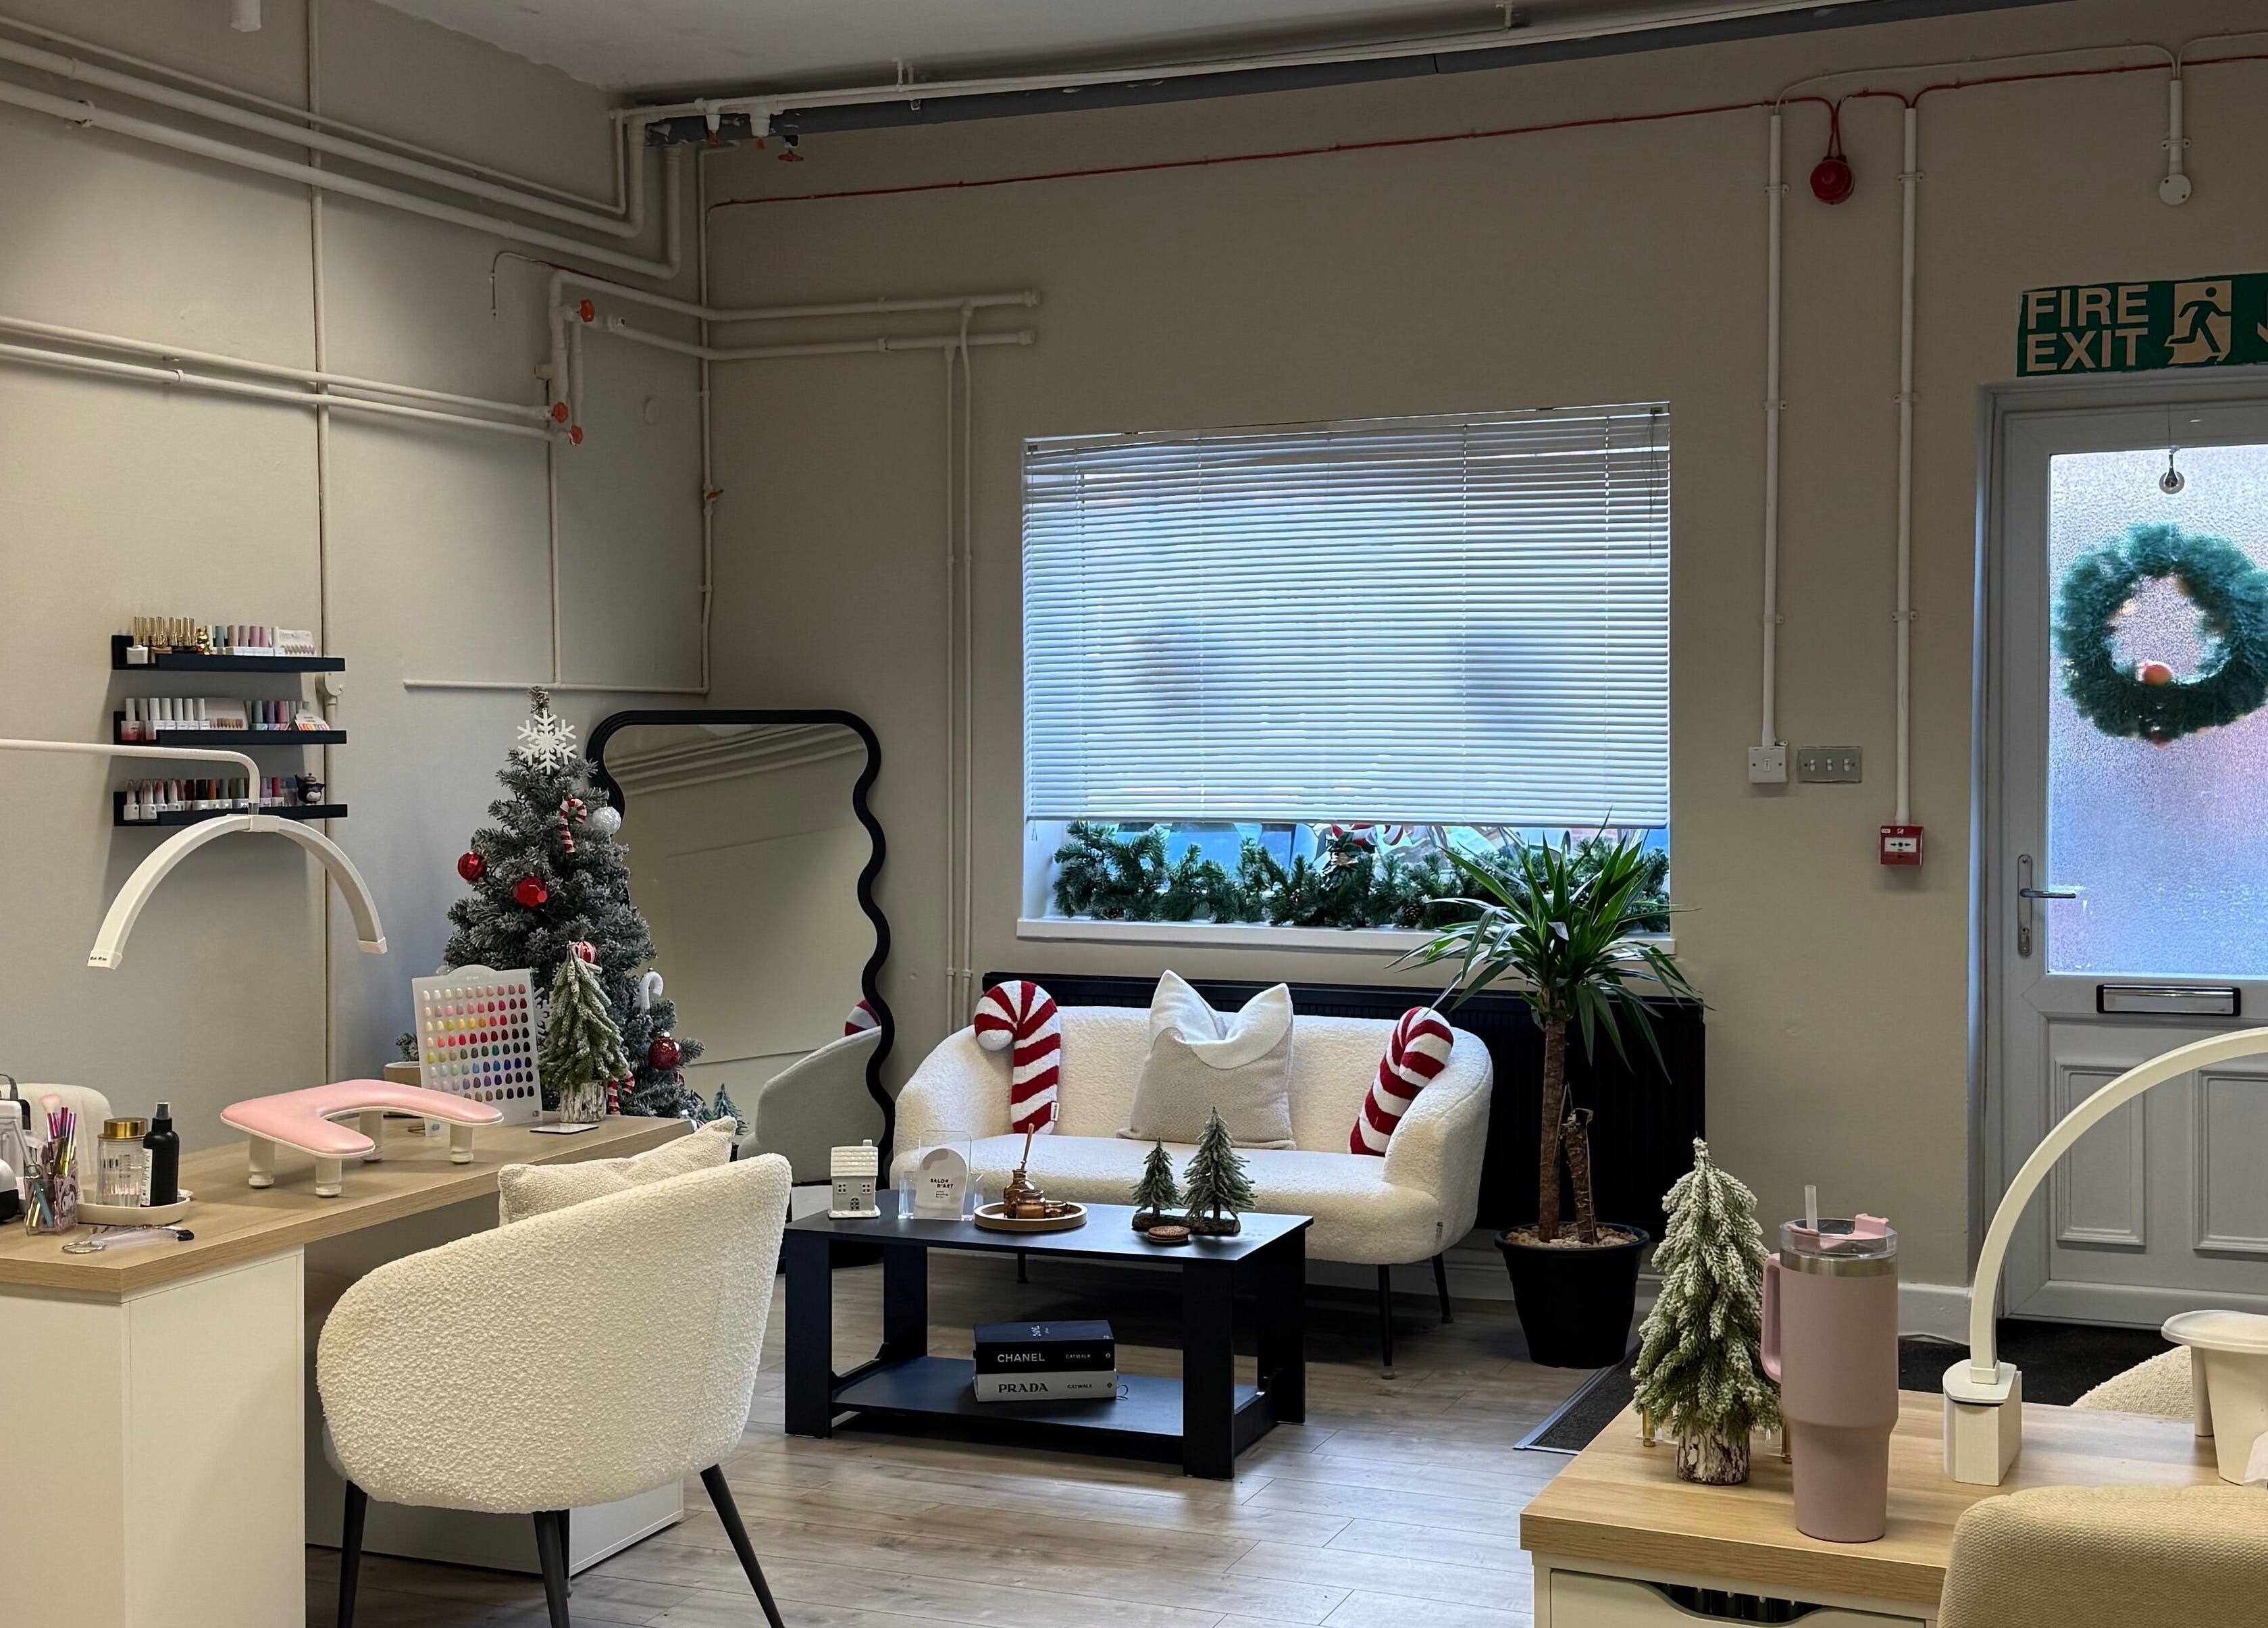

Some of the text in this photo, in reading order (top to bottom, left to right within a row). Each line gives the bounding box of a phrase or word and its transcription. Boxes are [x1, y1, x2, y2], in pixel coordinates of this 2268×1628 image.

[2027, 284, 2148, 330] FIRE
[2027, 328, 2148, 372] EXIT
[998, 1353, 1045, 1363] CHANEL
[998, 1383, 1048, 1394] PRADA
